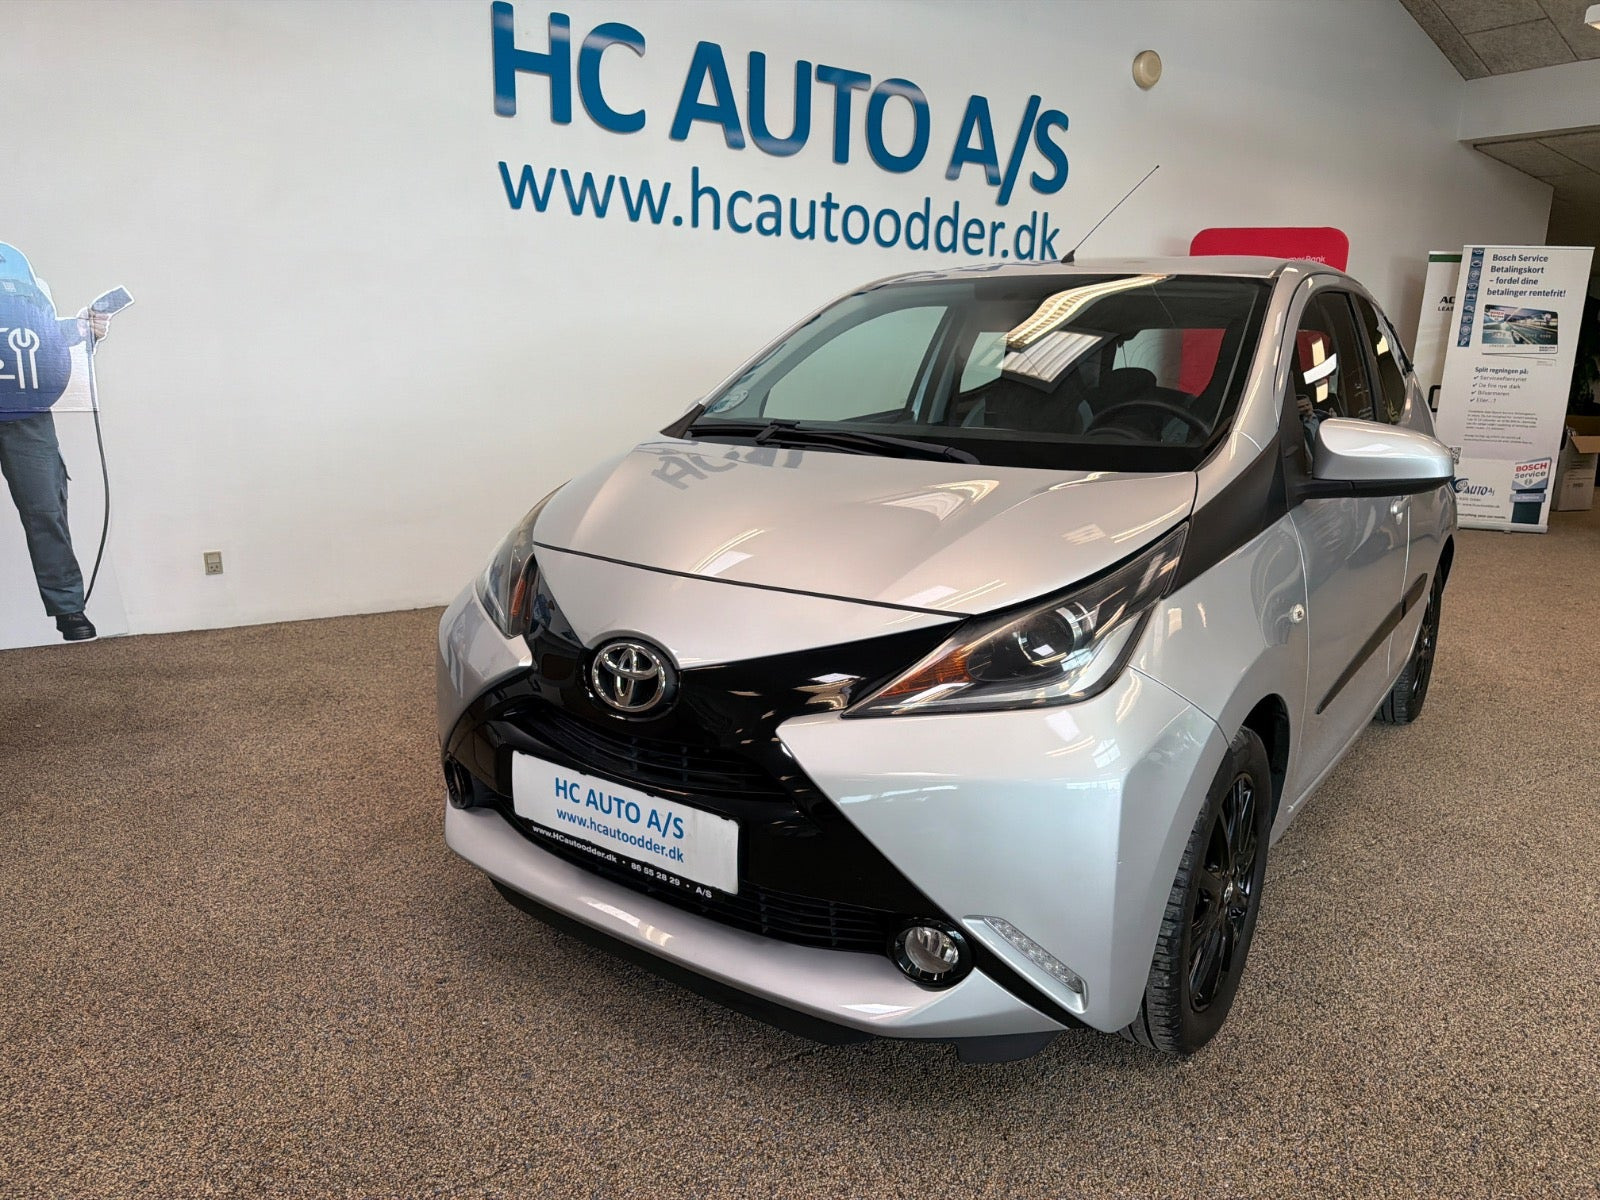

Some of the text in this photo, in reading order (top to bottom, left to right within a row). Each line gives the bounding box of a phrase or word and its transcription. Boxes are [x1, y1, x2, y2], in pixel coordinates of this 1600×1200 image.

[491, 0, 1070, 206] HC AUTO A/S
[498, 161, 1061, 261] www.hcautoodder.dk
[1492, 254, 1549, 263] Bosch Service
[1490, 265, 1544, 275] Betalingskort
[1495, 277, 1520, 285] fordel
[1521, 278, 1538, 286] dine
[1486, 288, 1566, 298] betalinger rentefrit!
[1475, 366, 1488, 374] Split
[1489, 367, 1519, 375] regningen
[1515, 462, 1548, 472] BOSCH
[1514, 471, 1546, 479] Service
[555, 776, 684, 840] HC AUTO A/S
[556, 808, 684, 863] www.hcautoodder.dk
[532, 825, 618, 863] www.HCautoodder.dk
[643, 866, 654, 877] 55
[656, 870, 668, 881] 28
[669, 874, 681, 886] 29
[695, 886, 712, 898] A/S
